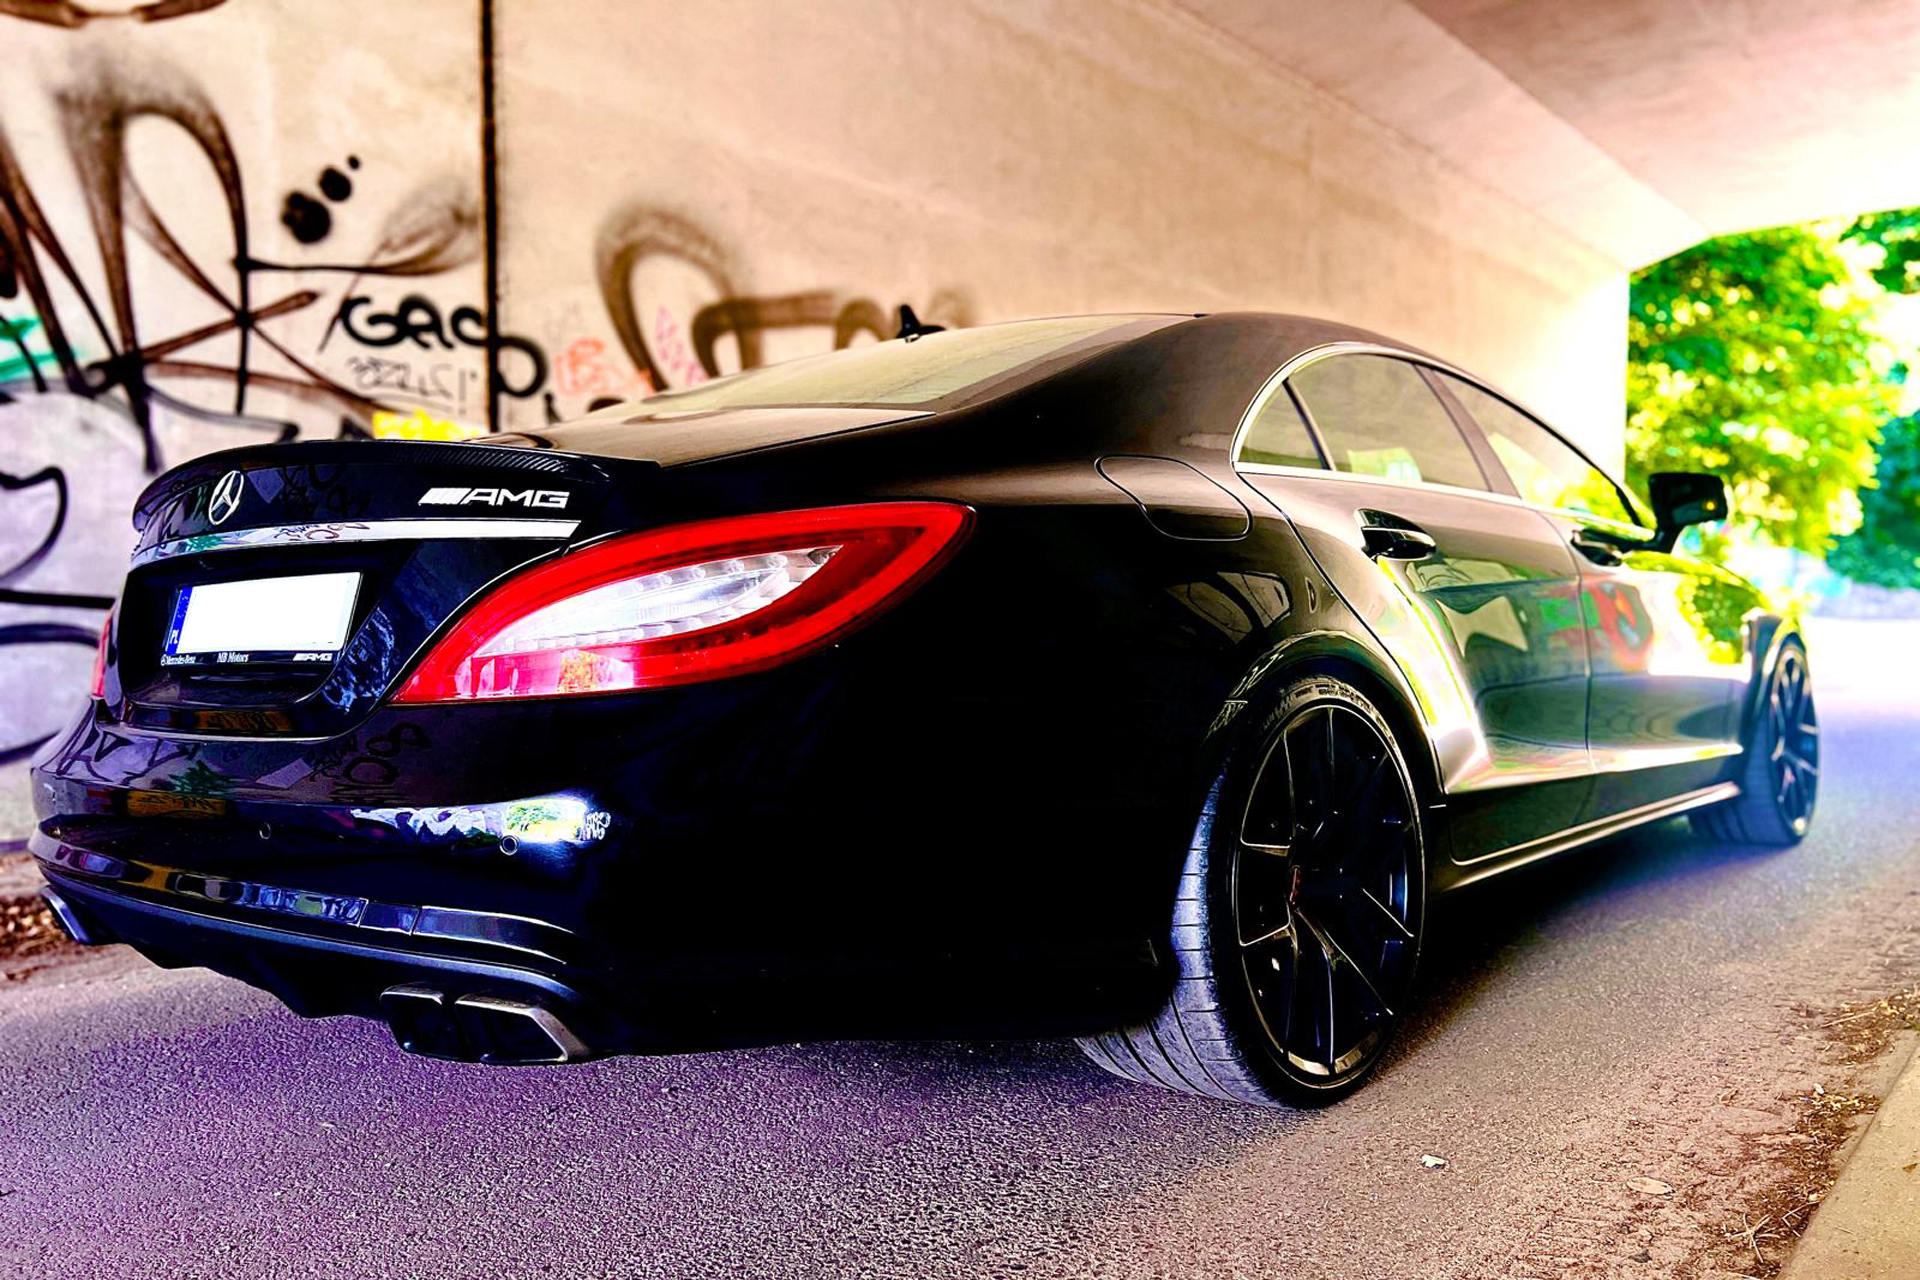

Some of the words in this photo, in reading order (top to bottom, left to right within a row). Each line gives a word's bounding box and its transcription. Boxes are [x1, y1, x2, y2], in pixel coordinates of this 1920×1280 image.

[459, 487, 571, 509] AMG
[227, 651, 250, 663] Motors
[307, 653, 333, 661] AMG
